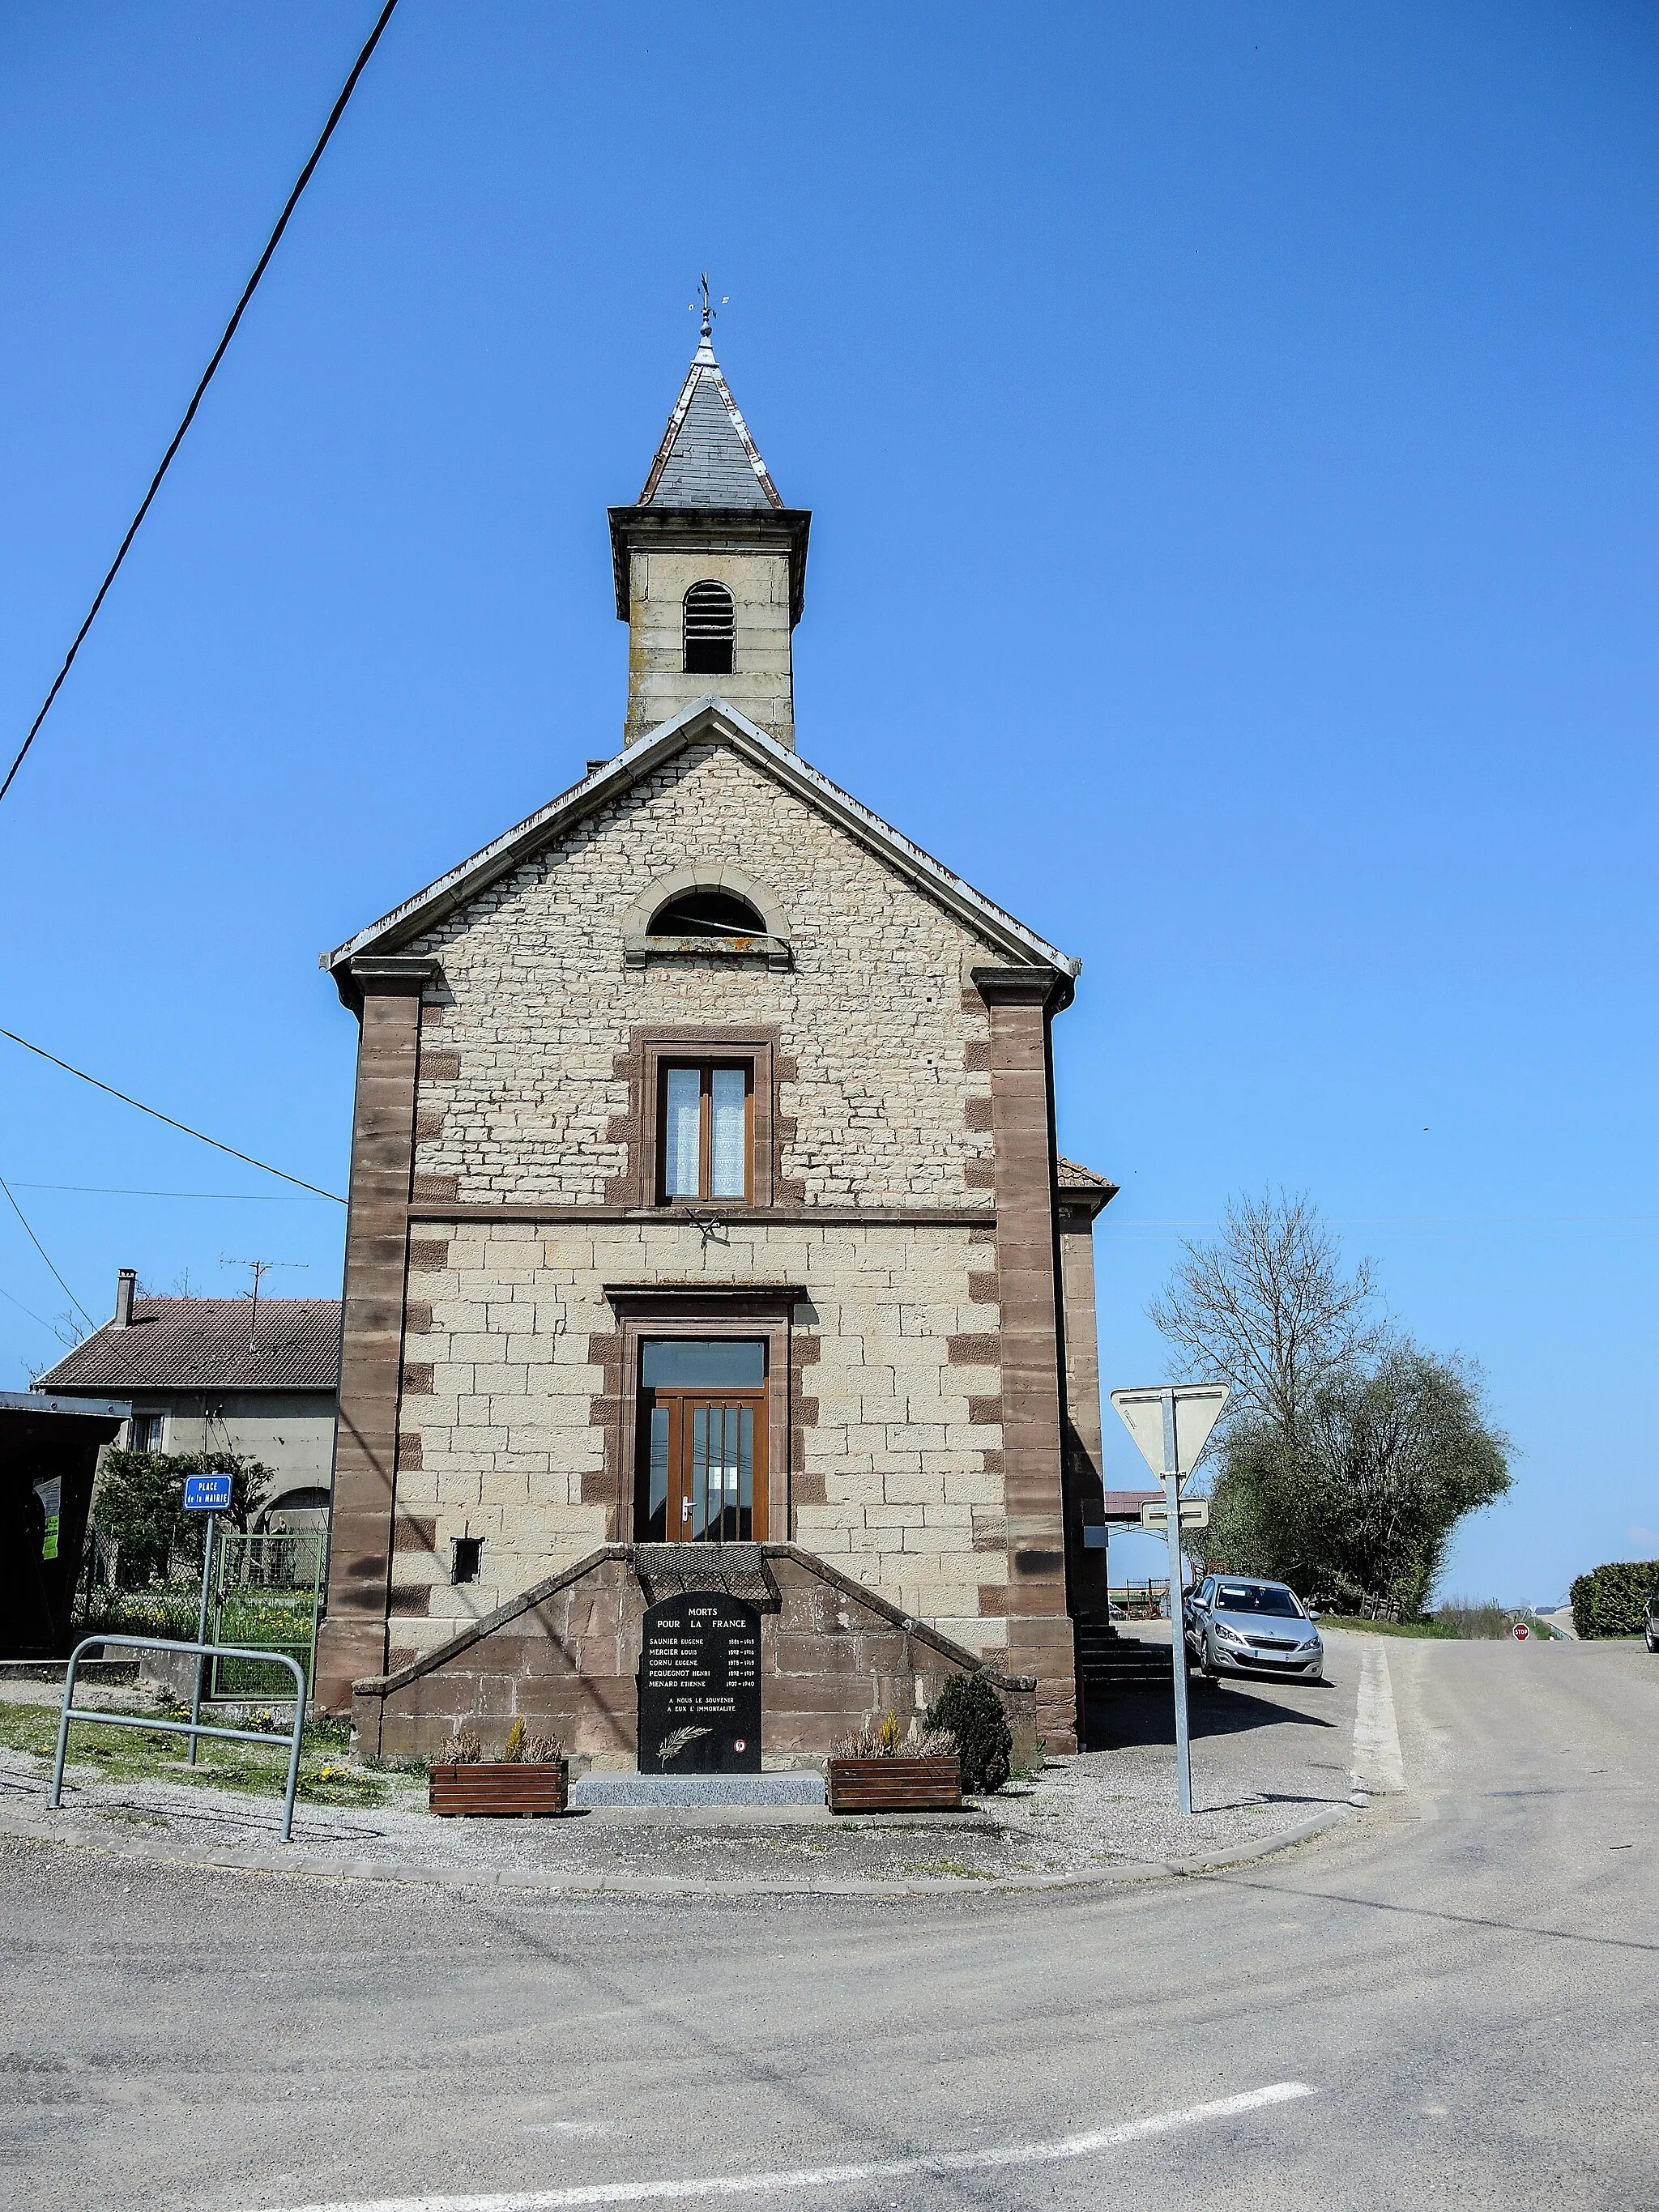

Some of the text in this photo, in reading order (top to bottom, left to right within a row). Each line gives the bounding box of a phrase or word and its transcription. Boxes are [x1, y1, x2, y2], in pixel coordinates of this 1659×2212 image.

[198, 1482, 217, 1491] PLACE
[187, 1494, 227, 1502] de la MAIRIE
[688, 1608, 718, 1616] MORTS
[657, 1620, 747, 1628] POUR LA FRANCE
